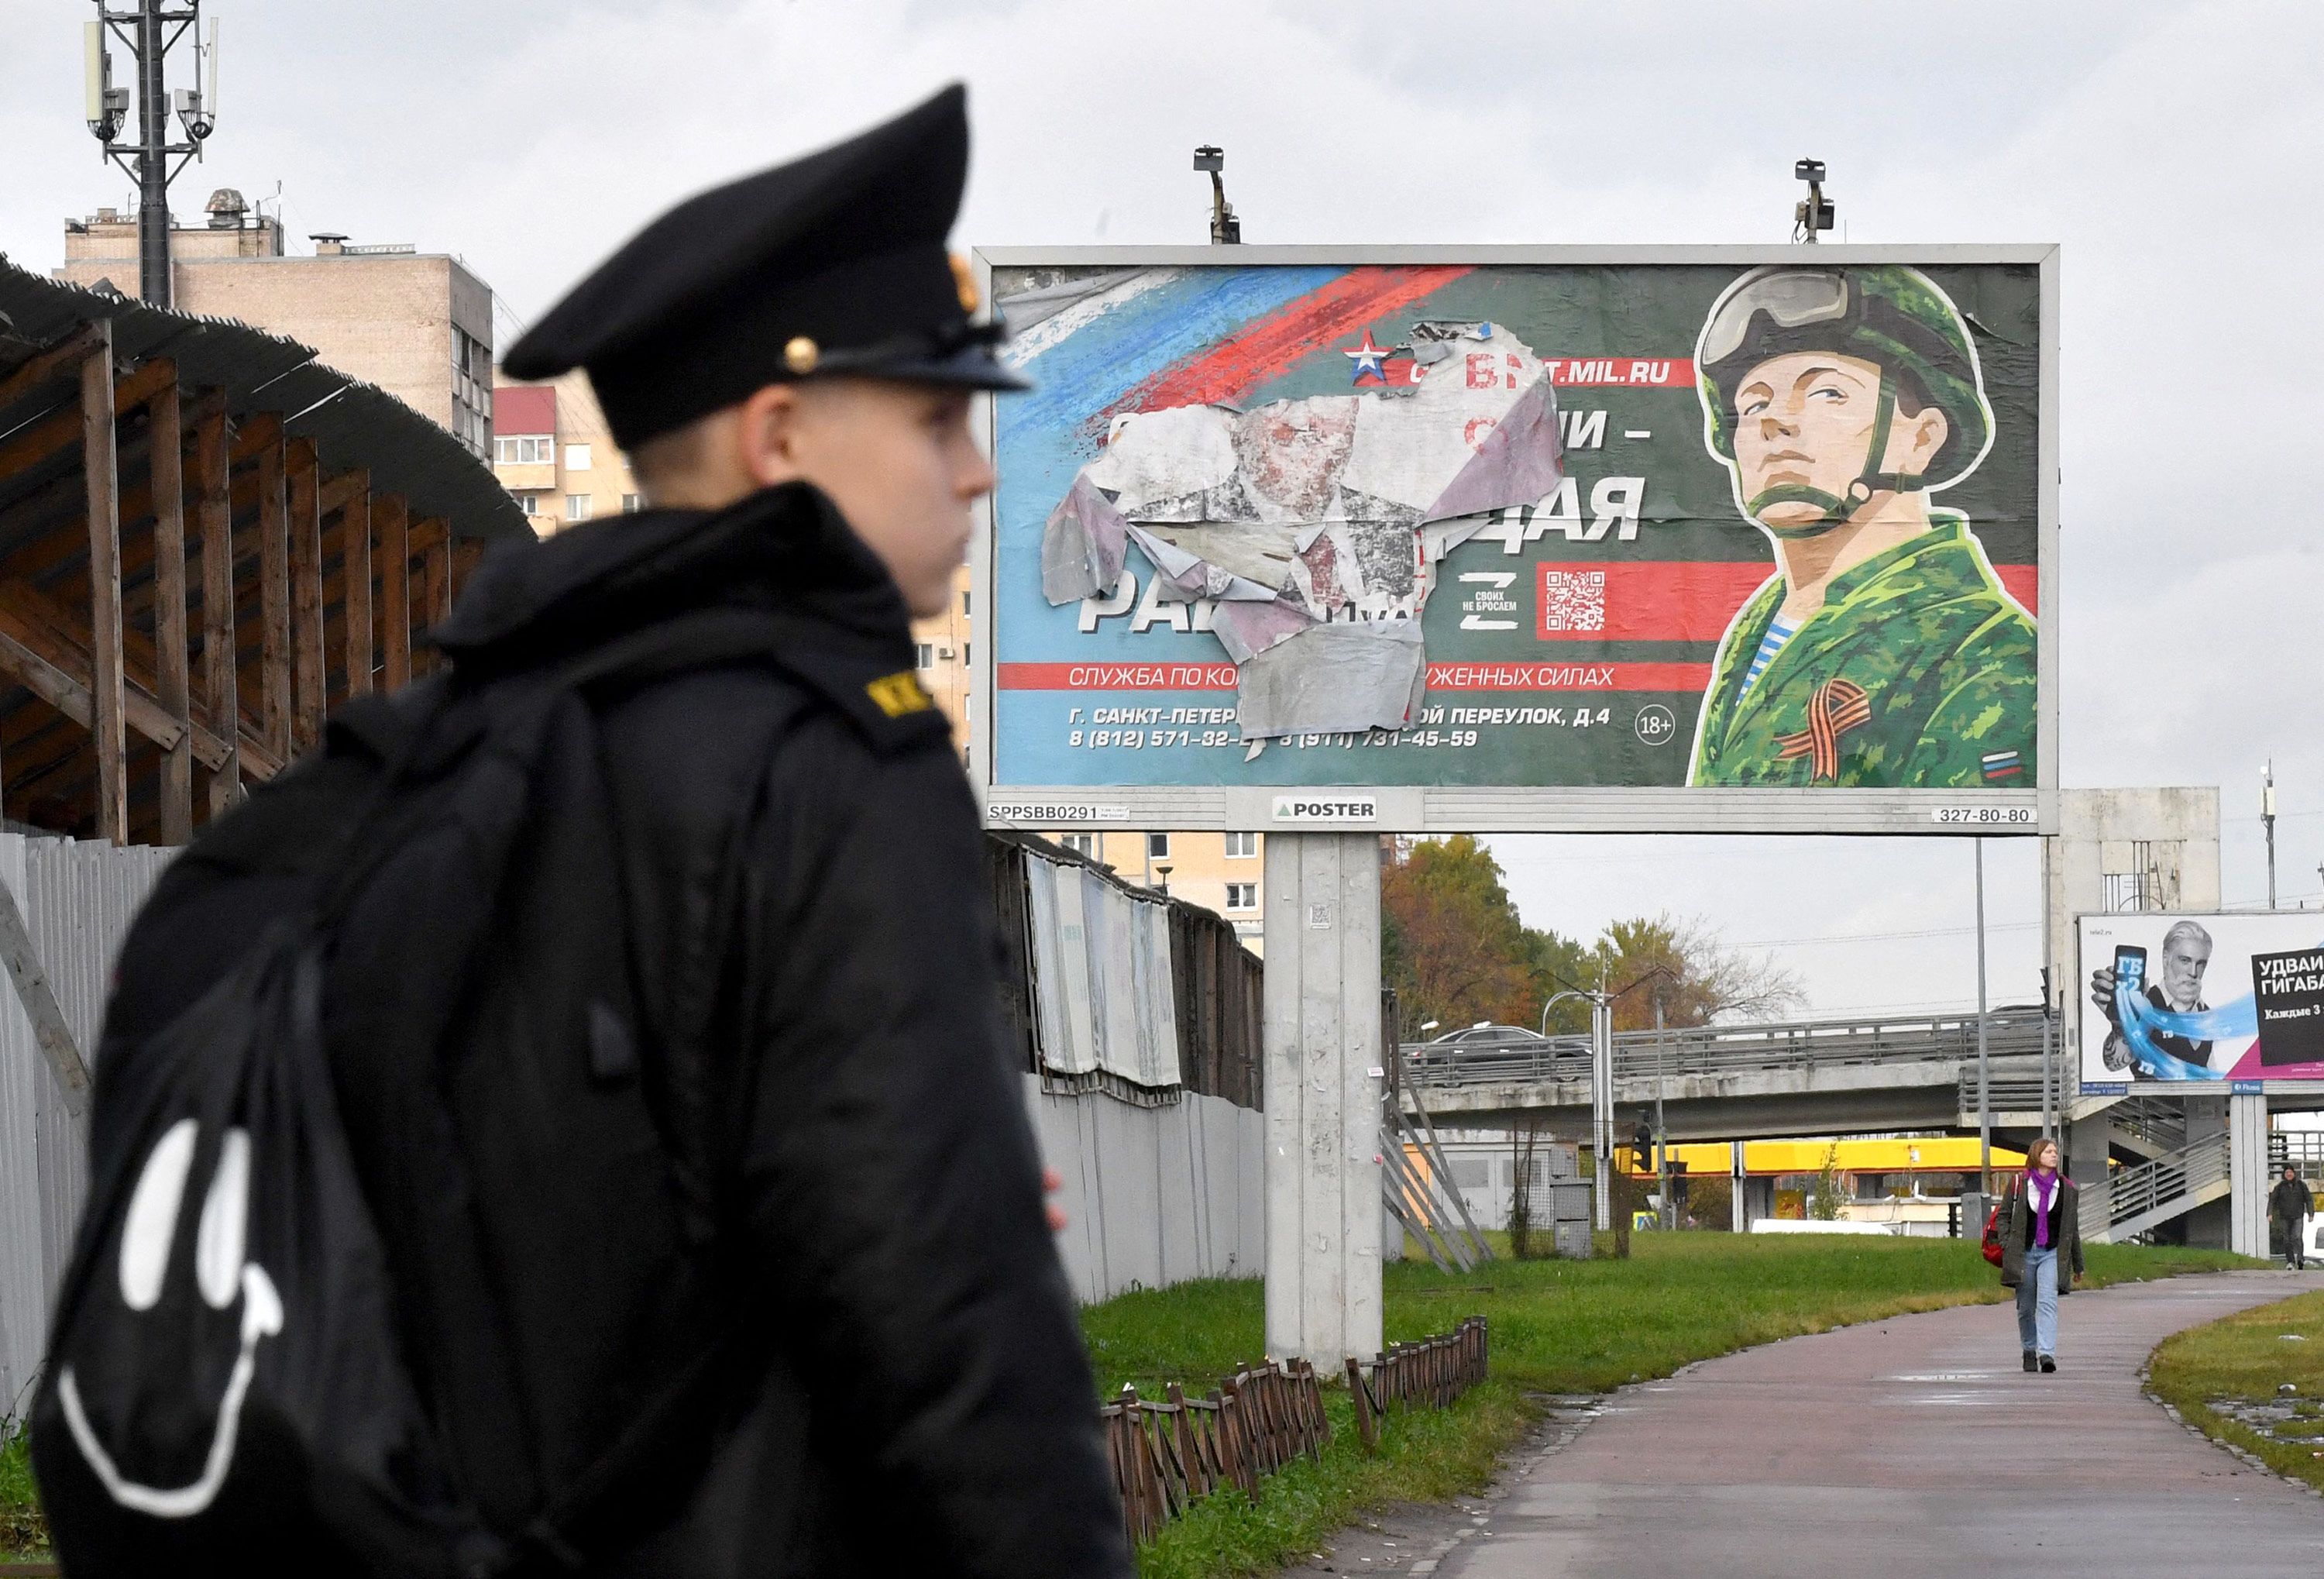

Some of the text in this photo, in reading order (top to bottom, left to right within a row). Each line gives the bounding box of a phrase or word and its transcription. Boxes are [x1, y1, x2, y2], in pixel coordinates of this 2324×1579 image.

[1545, 361, 1669, 384] T.MIL.RU
[1559, 411, 1607, 449] И
[1471, 476, 1645, 554] АЯ
[1078, 569, 1219, 632] РА
[1475, 591, 1504, 601] СВОИХ
[1463, 601, 1474, 611] НЕ
[1069, 667, 1164, 686] СЛУЖБА
[1170, 667, 1201, 686] ПО
[1205, 667, 1239, 686] КО
[1538, 667, 1614, 686] СИЛАХ
[1069, 703, 1610, 727] Г. САНКТ-ПЕТЕР ОЙ ПЕРЕУЛОК, Д.4
[1640, 717, 1671, 734] 18+
[1069, 731, 1084, 746] 8
[1088, 731, 1145, 748] (812)
[990, 806, 1096, 819] SPPSBB0291
[1294, 803, 1373, 817] POSTER
[1940, 809, 2029, 821] 327-80-80
[2259, 955, 2324, 978] УДВАИ
[2264, 1008, 2311, 1020] Каждые
